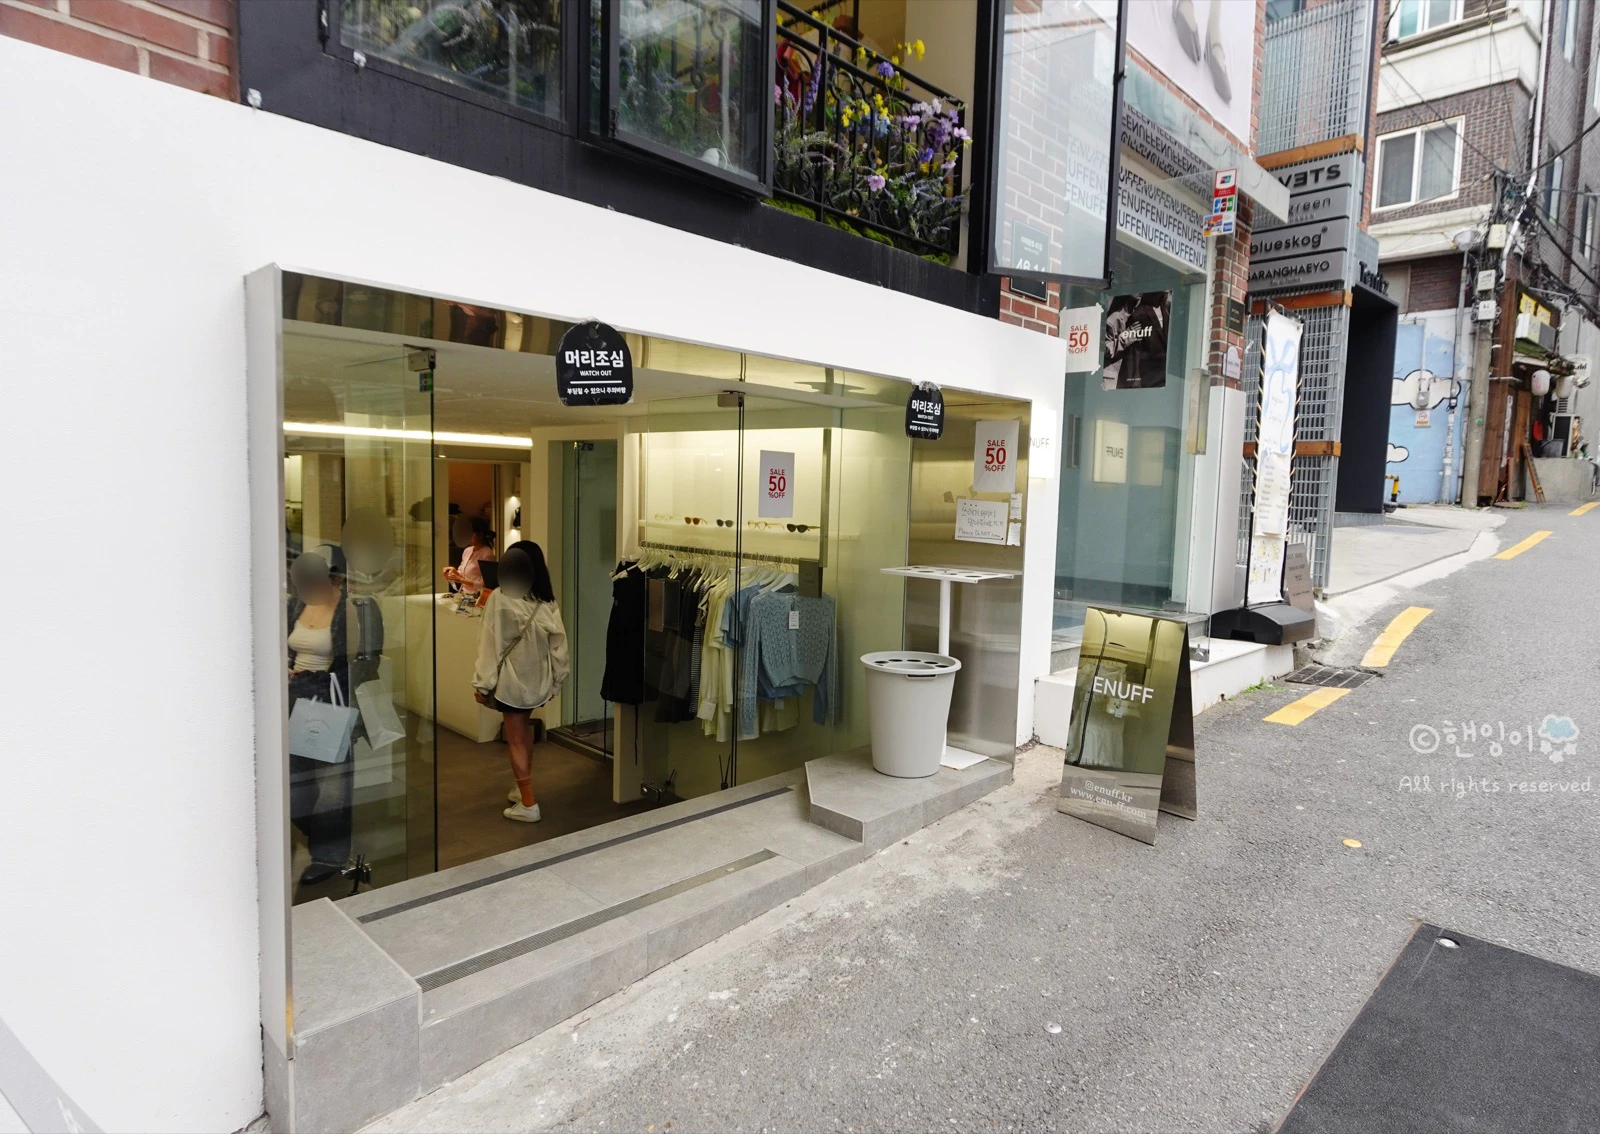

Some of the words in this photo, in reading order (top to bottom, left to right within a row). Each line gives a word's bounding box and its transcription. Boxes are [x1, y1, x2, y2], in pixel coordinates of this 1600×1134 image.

[1070, 324, 1088, 332] SALE
[1121, 325, 1153, 339] enuff
[1069, 331, 1089, 348] 50
[1068, 346, 1088, 354] %OFF
[565, 349, 624, 368] 머리조심
[911, 399, 941, 416] 머리조심
[987, 439, 1005, 447] SALE
[985, 447, 1007, 465] 50
[769, 468, 785, 476] SALE
[984, 464, 1006, 472] %OFF
[768, 475, 786, 492] 50
[768, 491, 786, 499] %OFF
[1092, 676, 1155, 704] ENUFF
